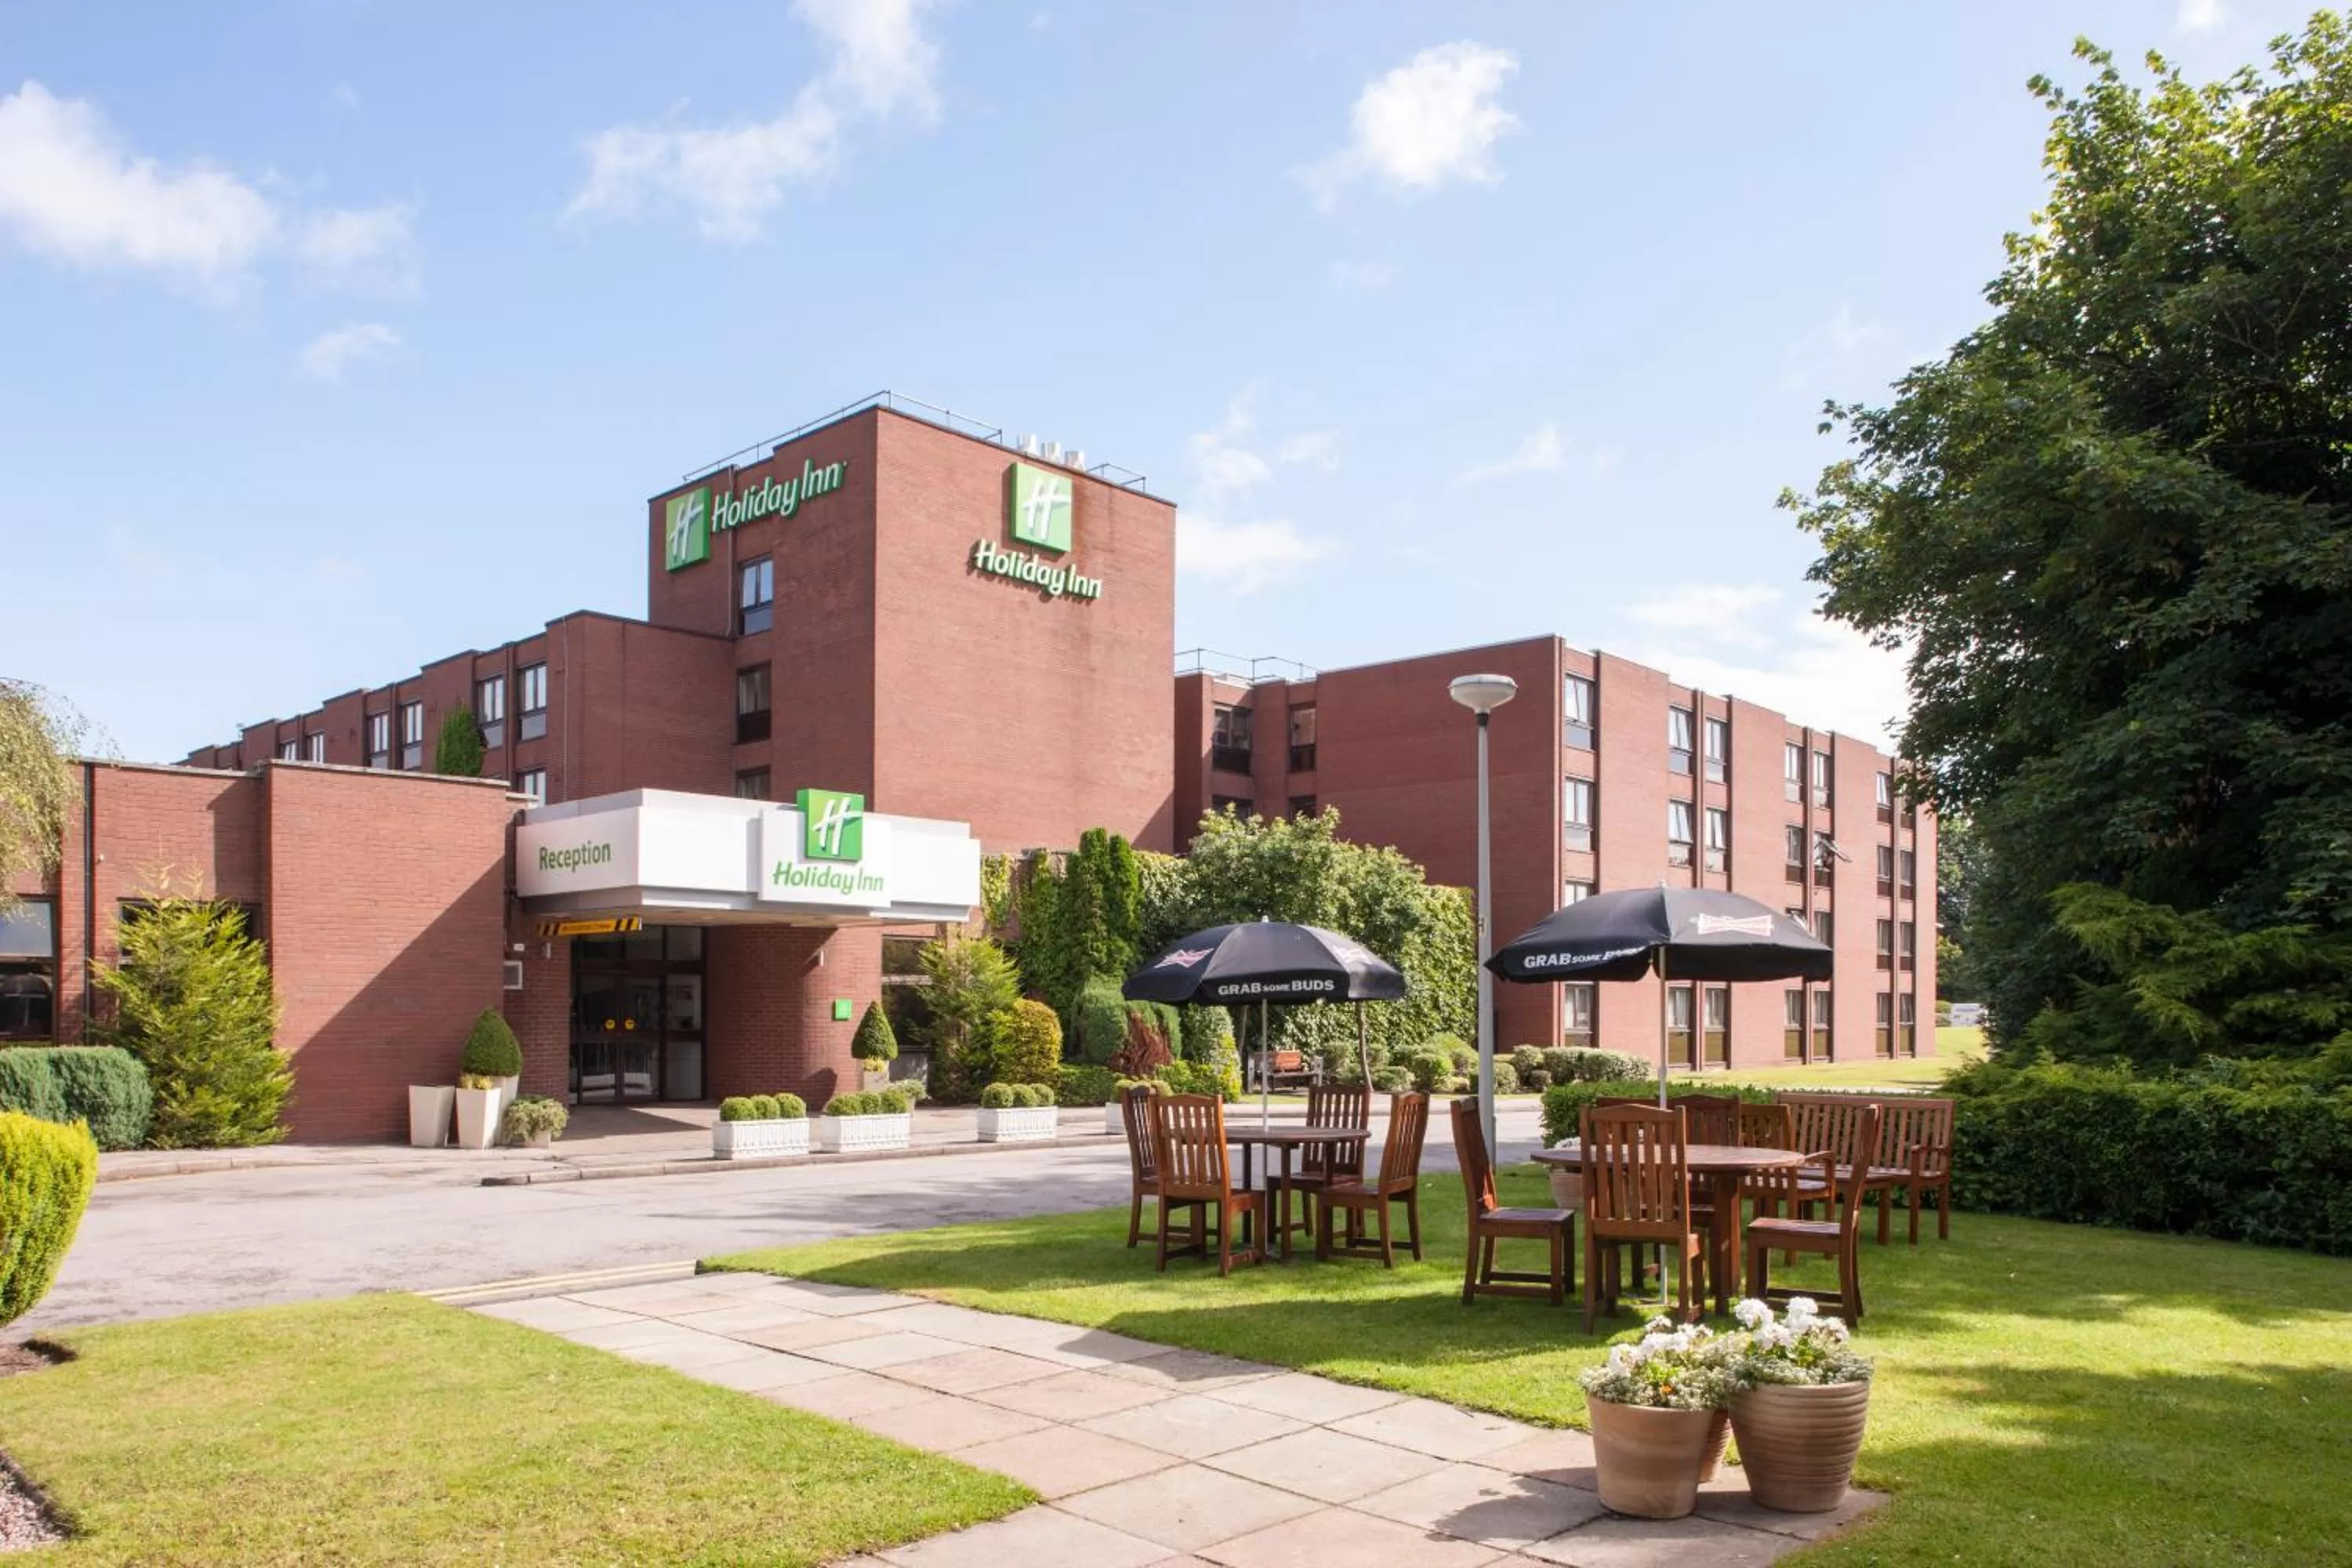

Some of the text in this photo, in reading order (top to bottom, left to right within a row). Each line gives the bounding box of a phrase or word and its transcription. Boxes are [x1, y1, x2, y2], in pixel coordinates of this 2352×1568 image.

[711, 459, 844, 533] Holiday Inn
[975, 539, 1102, 599] Holiday Inn
[539, 840, 612, 873] Reception
[773, 861, 885, 895] Holiday Inn
[1523, 953, 1570, 968] GRAB
[1218, 980, 1335, 996] GRAB SOME BUDS
